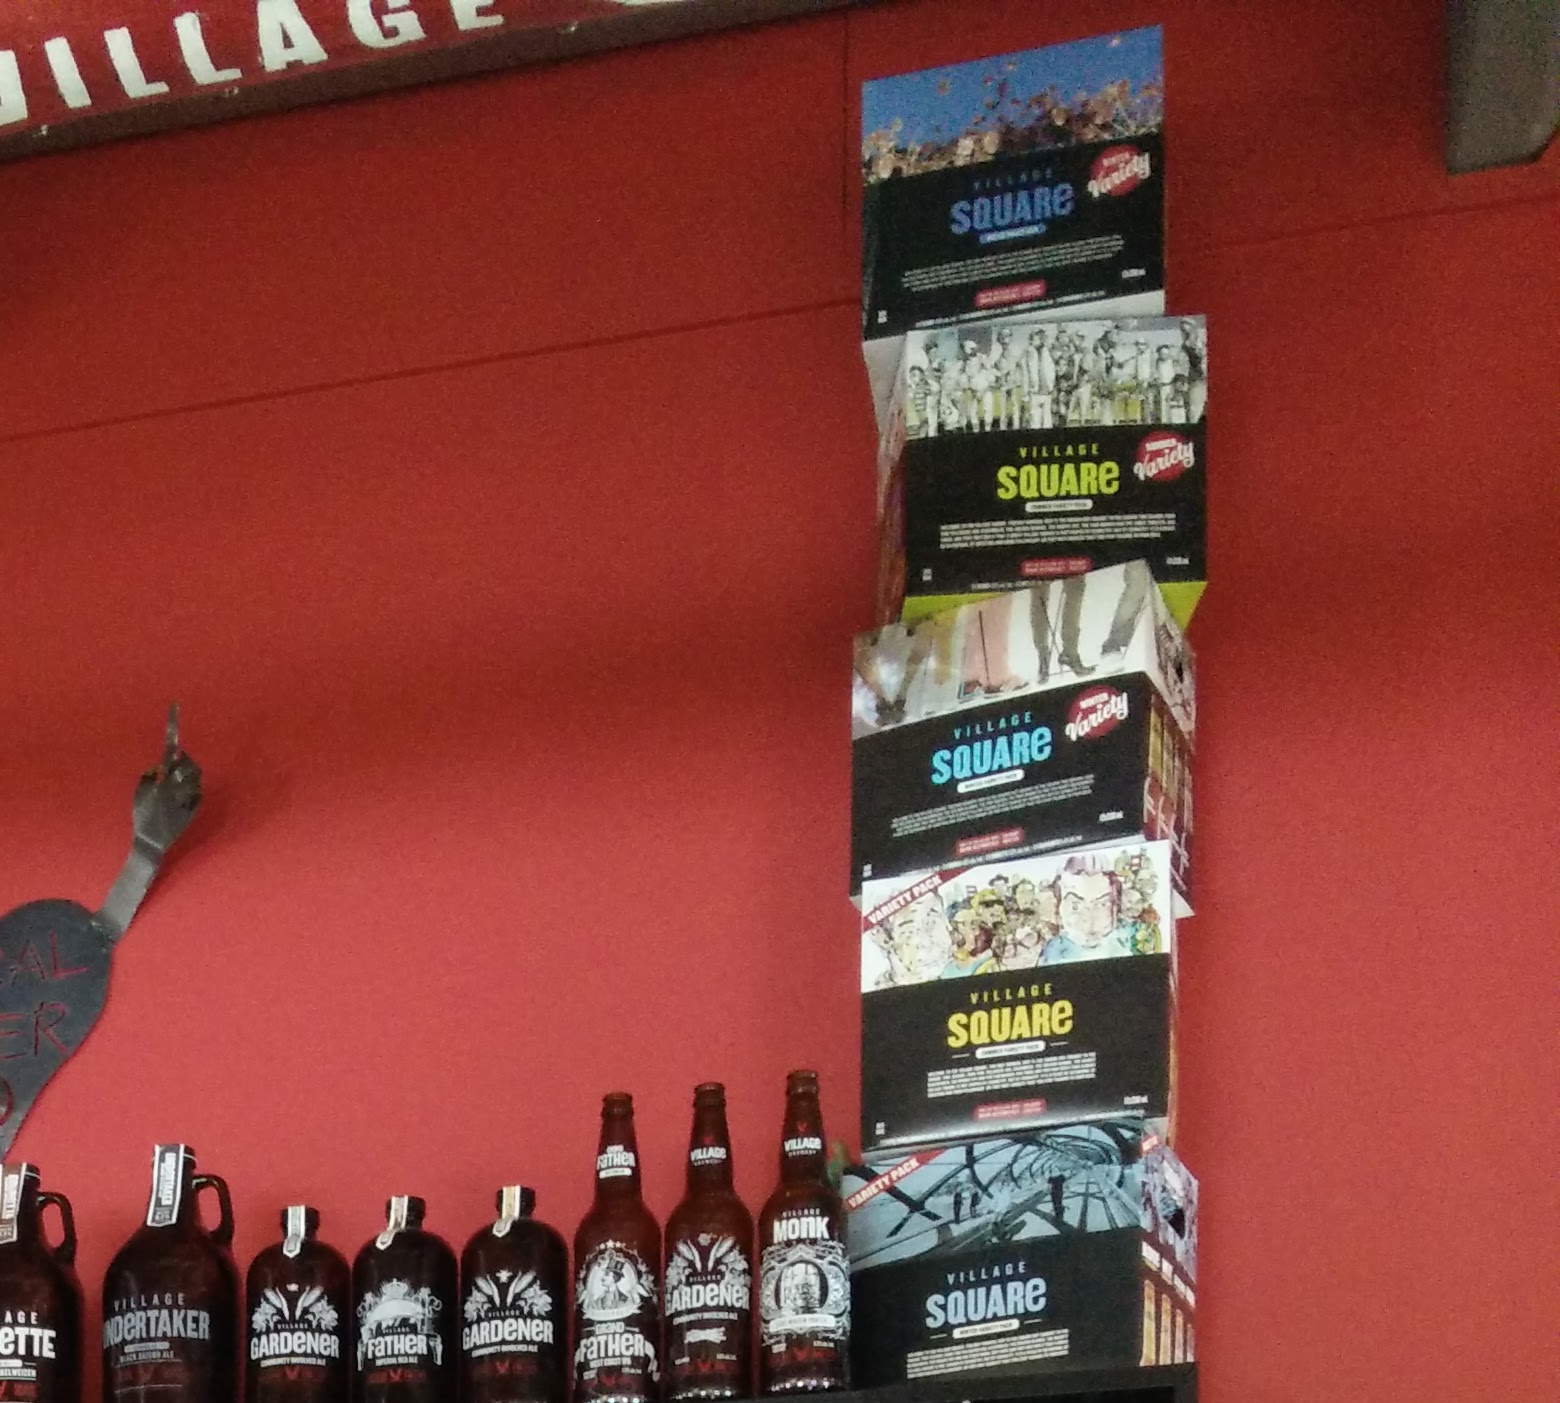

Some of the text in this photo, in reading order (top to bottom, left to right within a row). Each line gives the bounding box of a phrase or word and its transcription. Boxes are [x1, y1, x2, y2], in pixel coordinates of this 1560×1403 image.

[1019, 443, 1100, 459] VILLAGE
[1133, 441, 1195, 481] Variety
[953, 710, 1033, 740] VILLAGE
[1065, 691, 1129, 742] Variety
[869, 873, 943, 925] VARIETY PACK
[970, 983, 1053, 1005] VILLAGE
[848, 1157, 920, 1208] VARIETY PACK
[948, 1261, 1026, 1285] VILLAGE
[114, 1293, 184, 1312] VILLAGE
